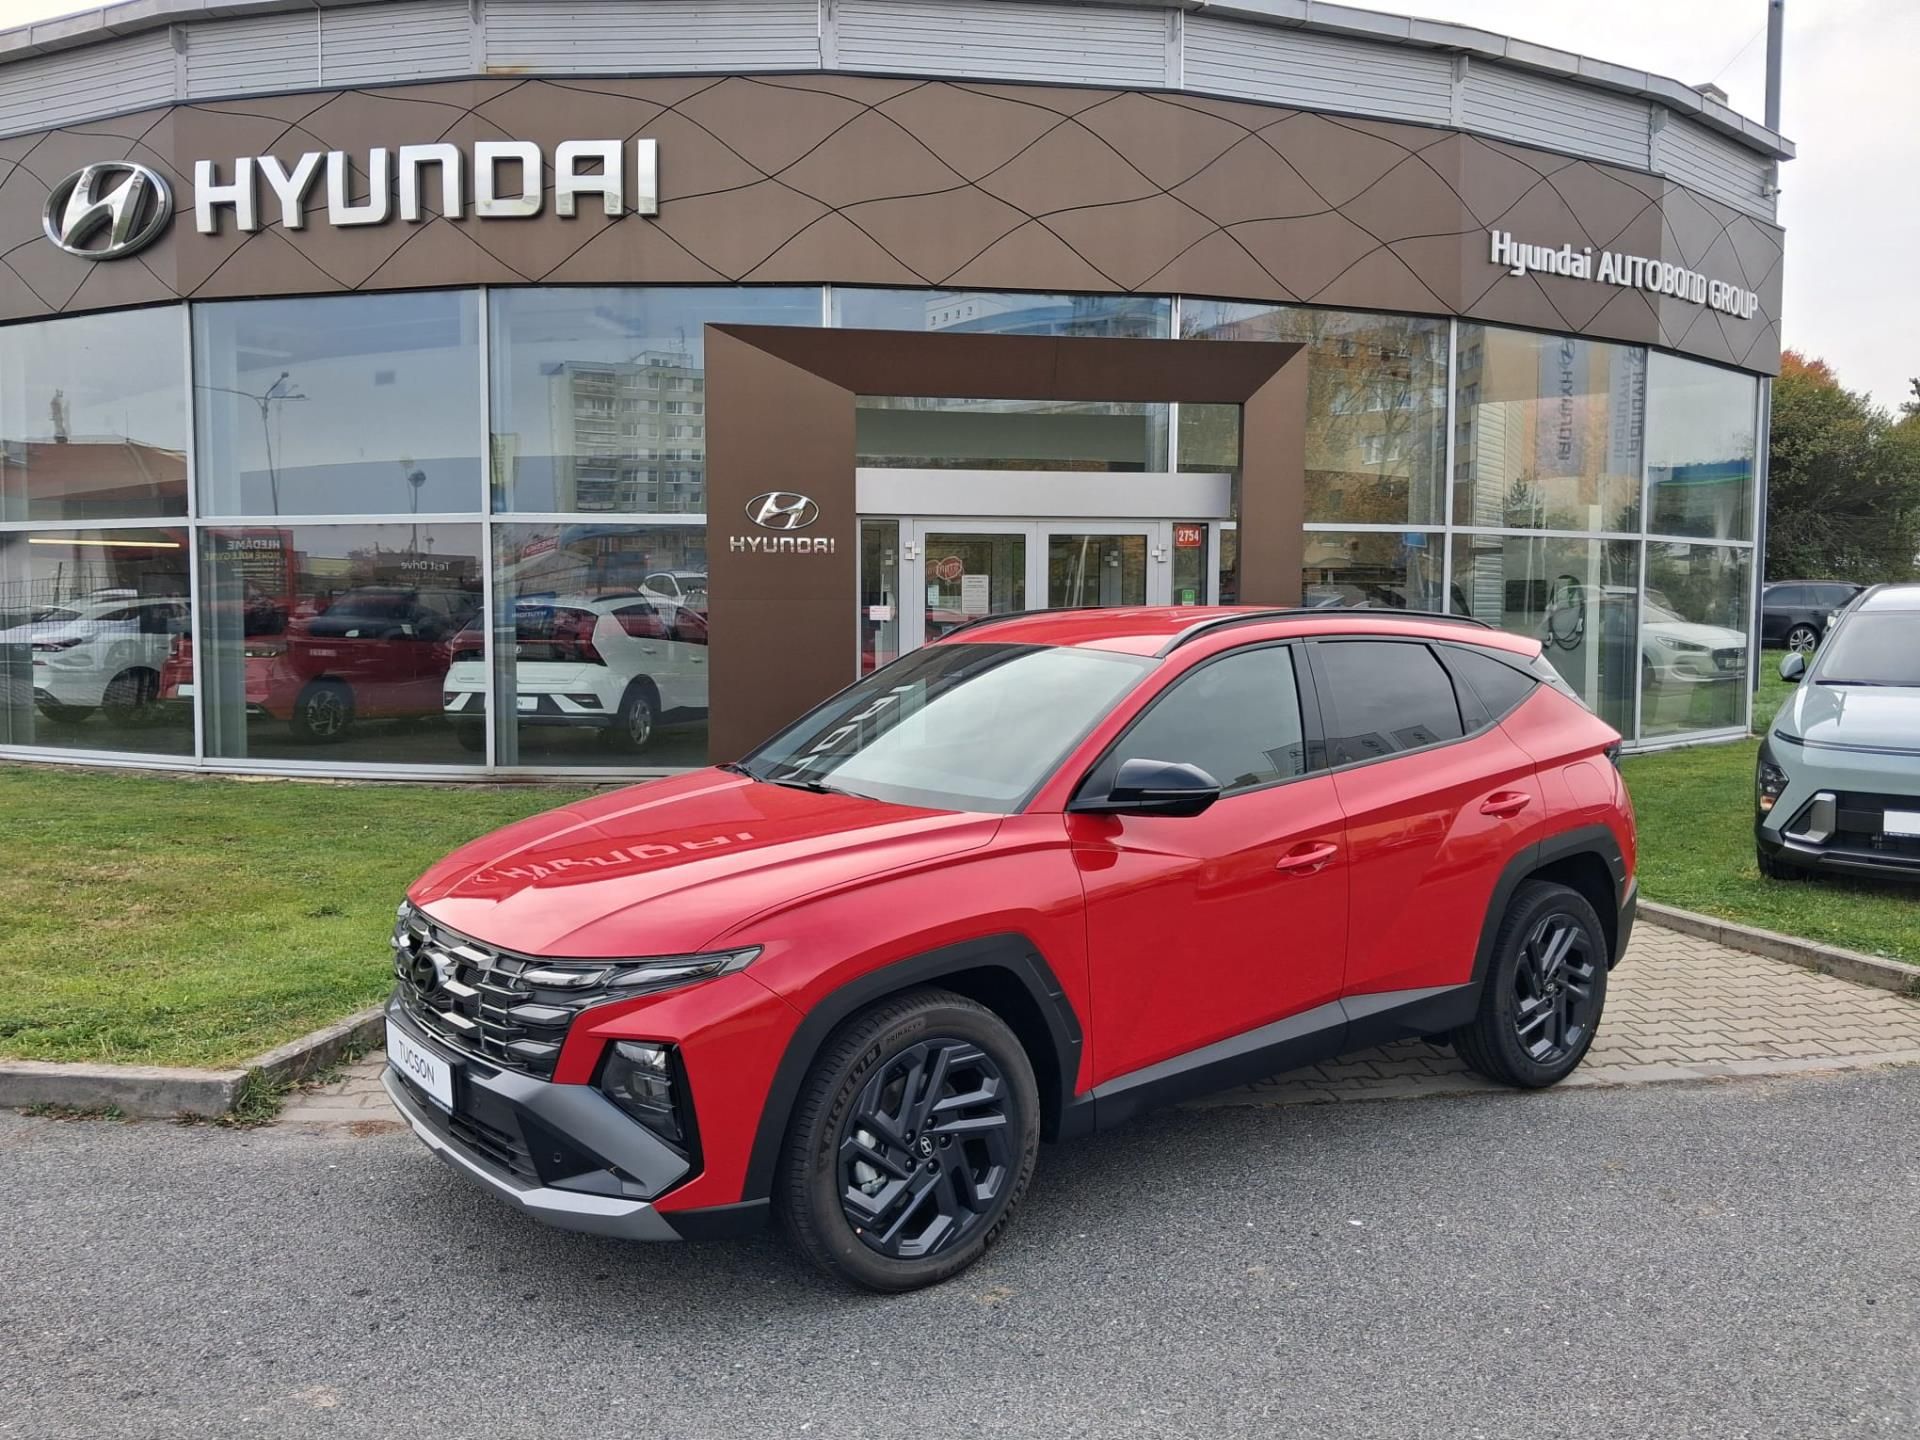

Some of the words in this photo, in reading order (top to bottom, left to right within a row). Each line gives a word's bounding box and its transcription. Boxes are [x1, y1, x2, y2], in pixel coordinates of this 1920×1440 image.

[194, 138, 659, 234] HYUNDAI
[1491, 230, 1592, 279] Hyundai
[1596, 251, 1707, 304] AUTOBOND
[1708, 279, 1759, 319] GROUP
[1557, 371, 1573, 460] HYUNDAI
[1627, 372, 1644, 459] HYUNDAI
[728, 535, 836, 554] HYUNDAI
[1178, 529, 1200, 543] 2754
[399, 1040, 435, 1086] TUCSON
[822, 1045, 879, 1147] MICHELIN
